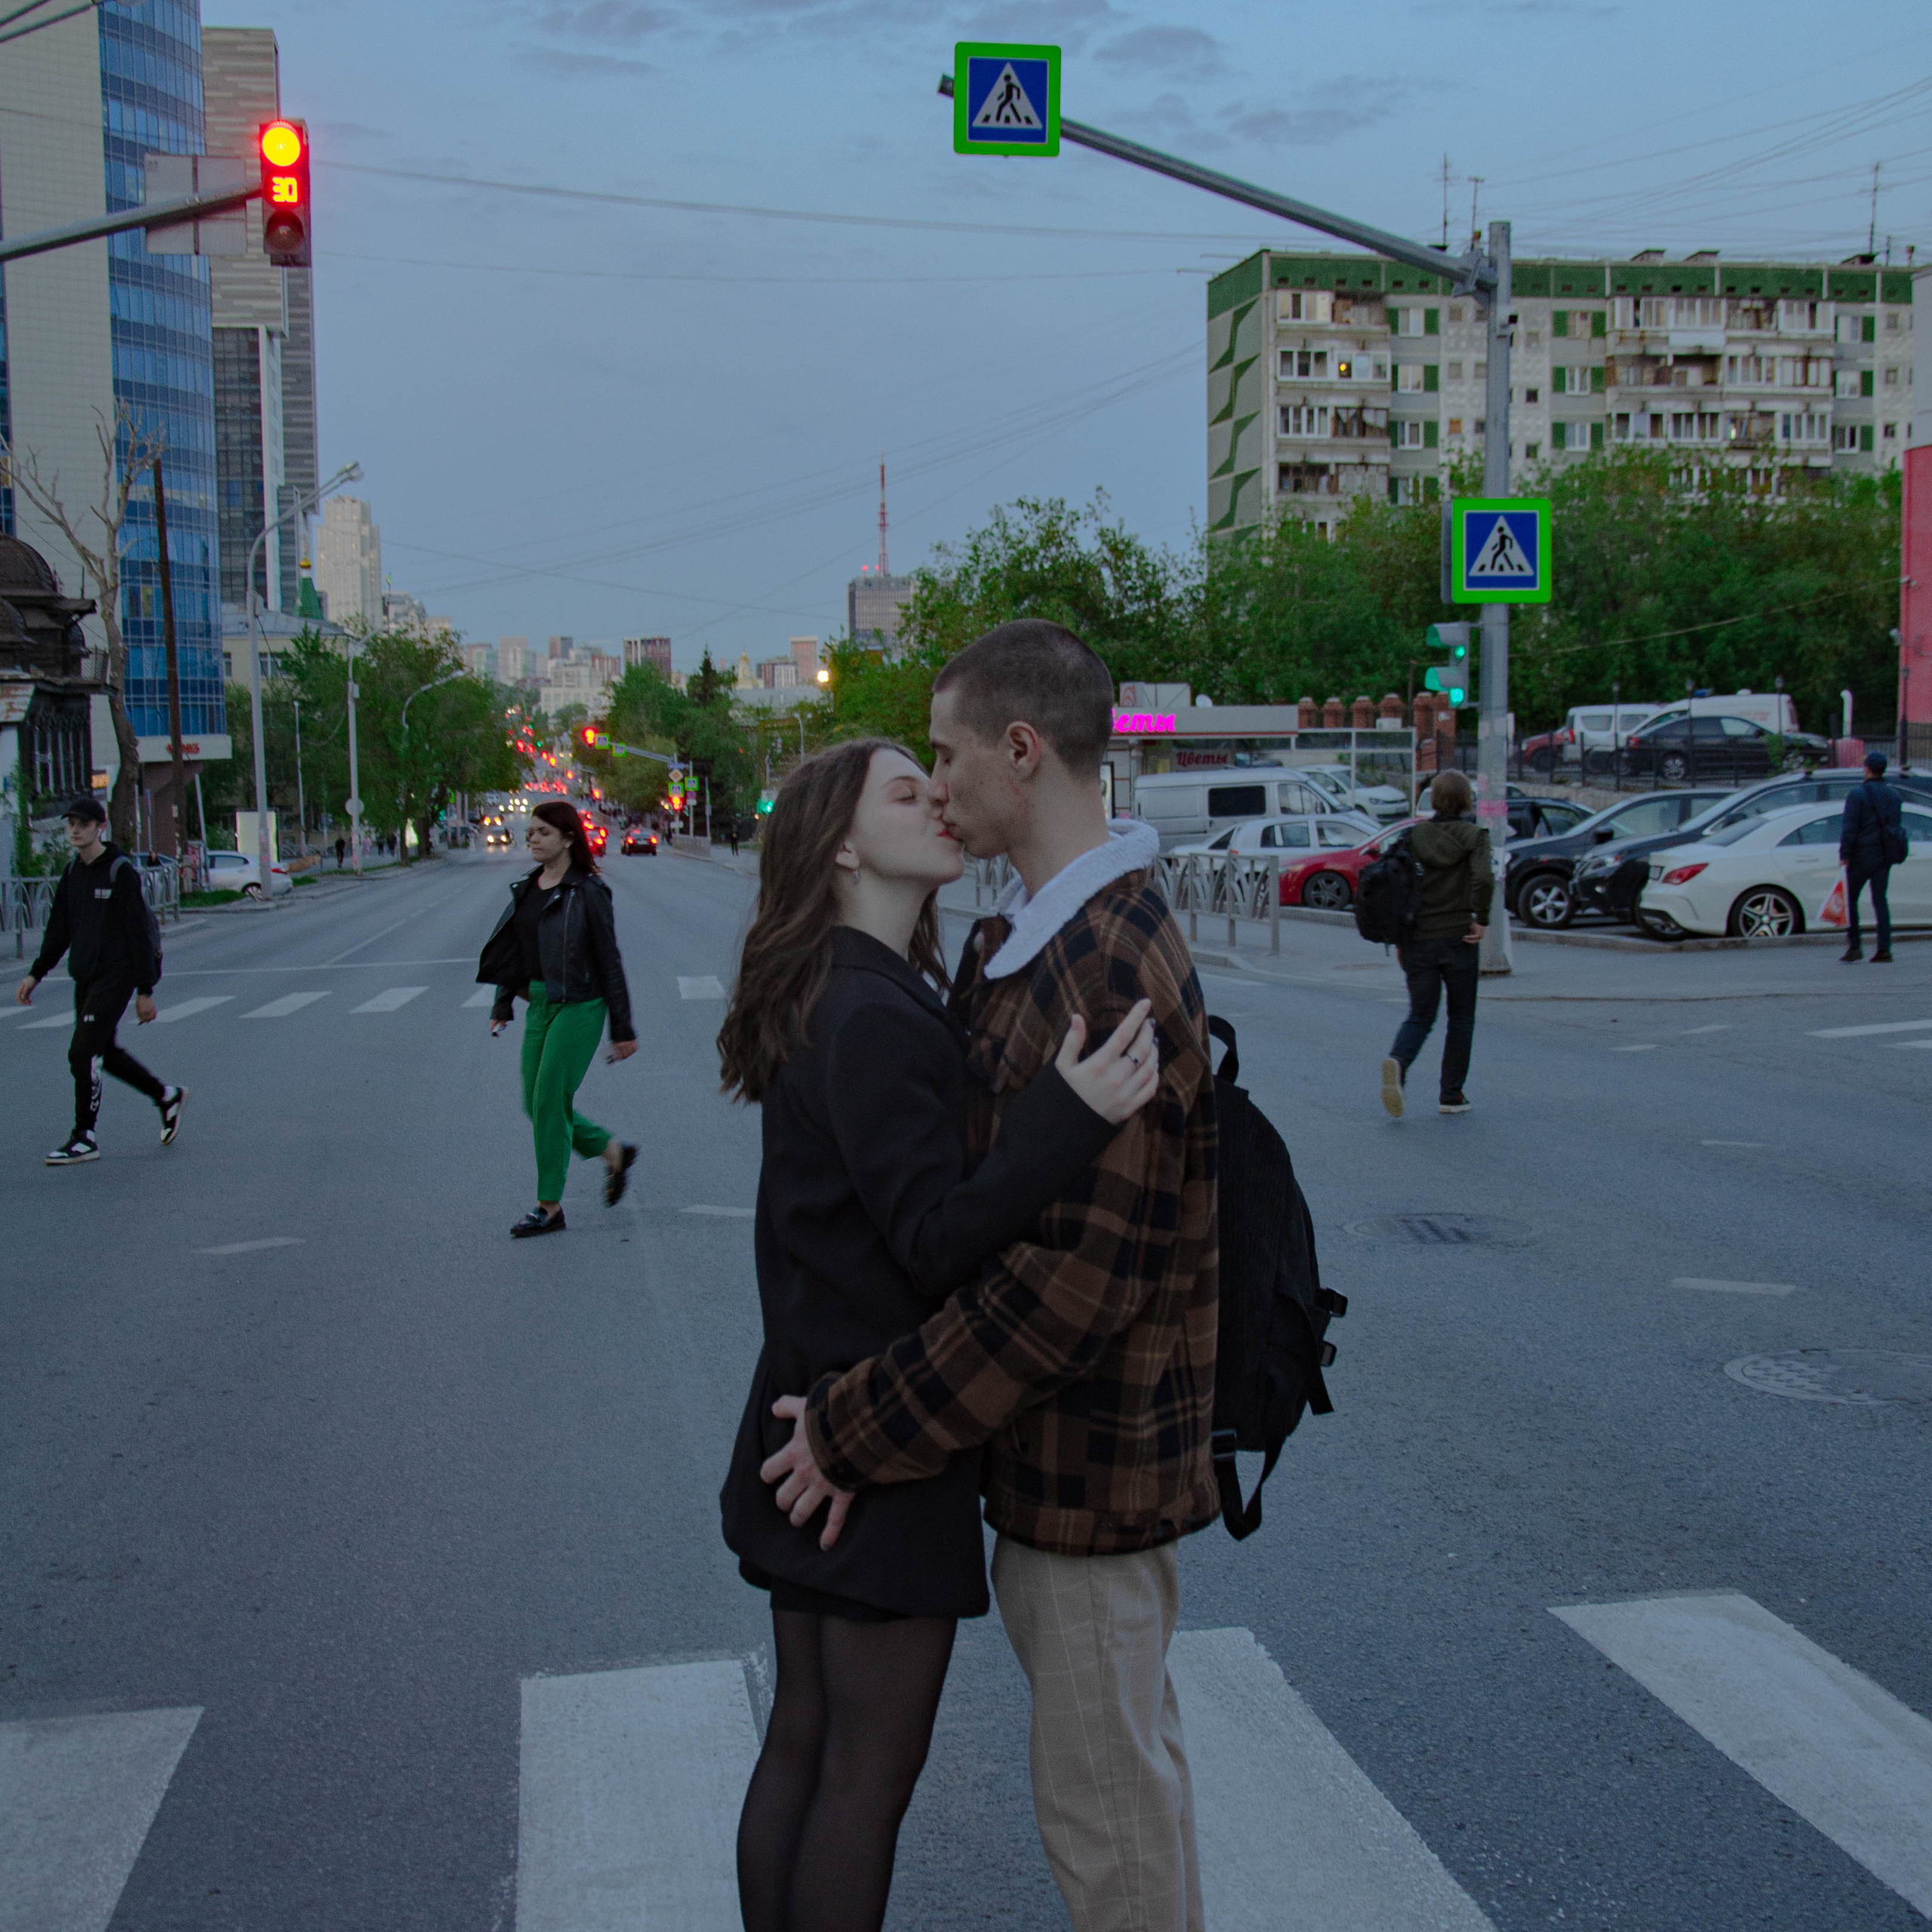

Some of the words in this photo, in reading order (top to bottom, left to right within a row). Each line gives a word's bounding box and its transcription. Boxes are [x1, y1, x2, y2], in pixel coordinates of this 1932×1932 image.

[272, 177, 297, 202] 30
[1112, 708, 1175, 733] еты
[1177, 752, 1227, 767] Цветы
